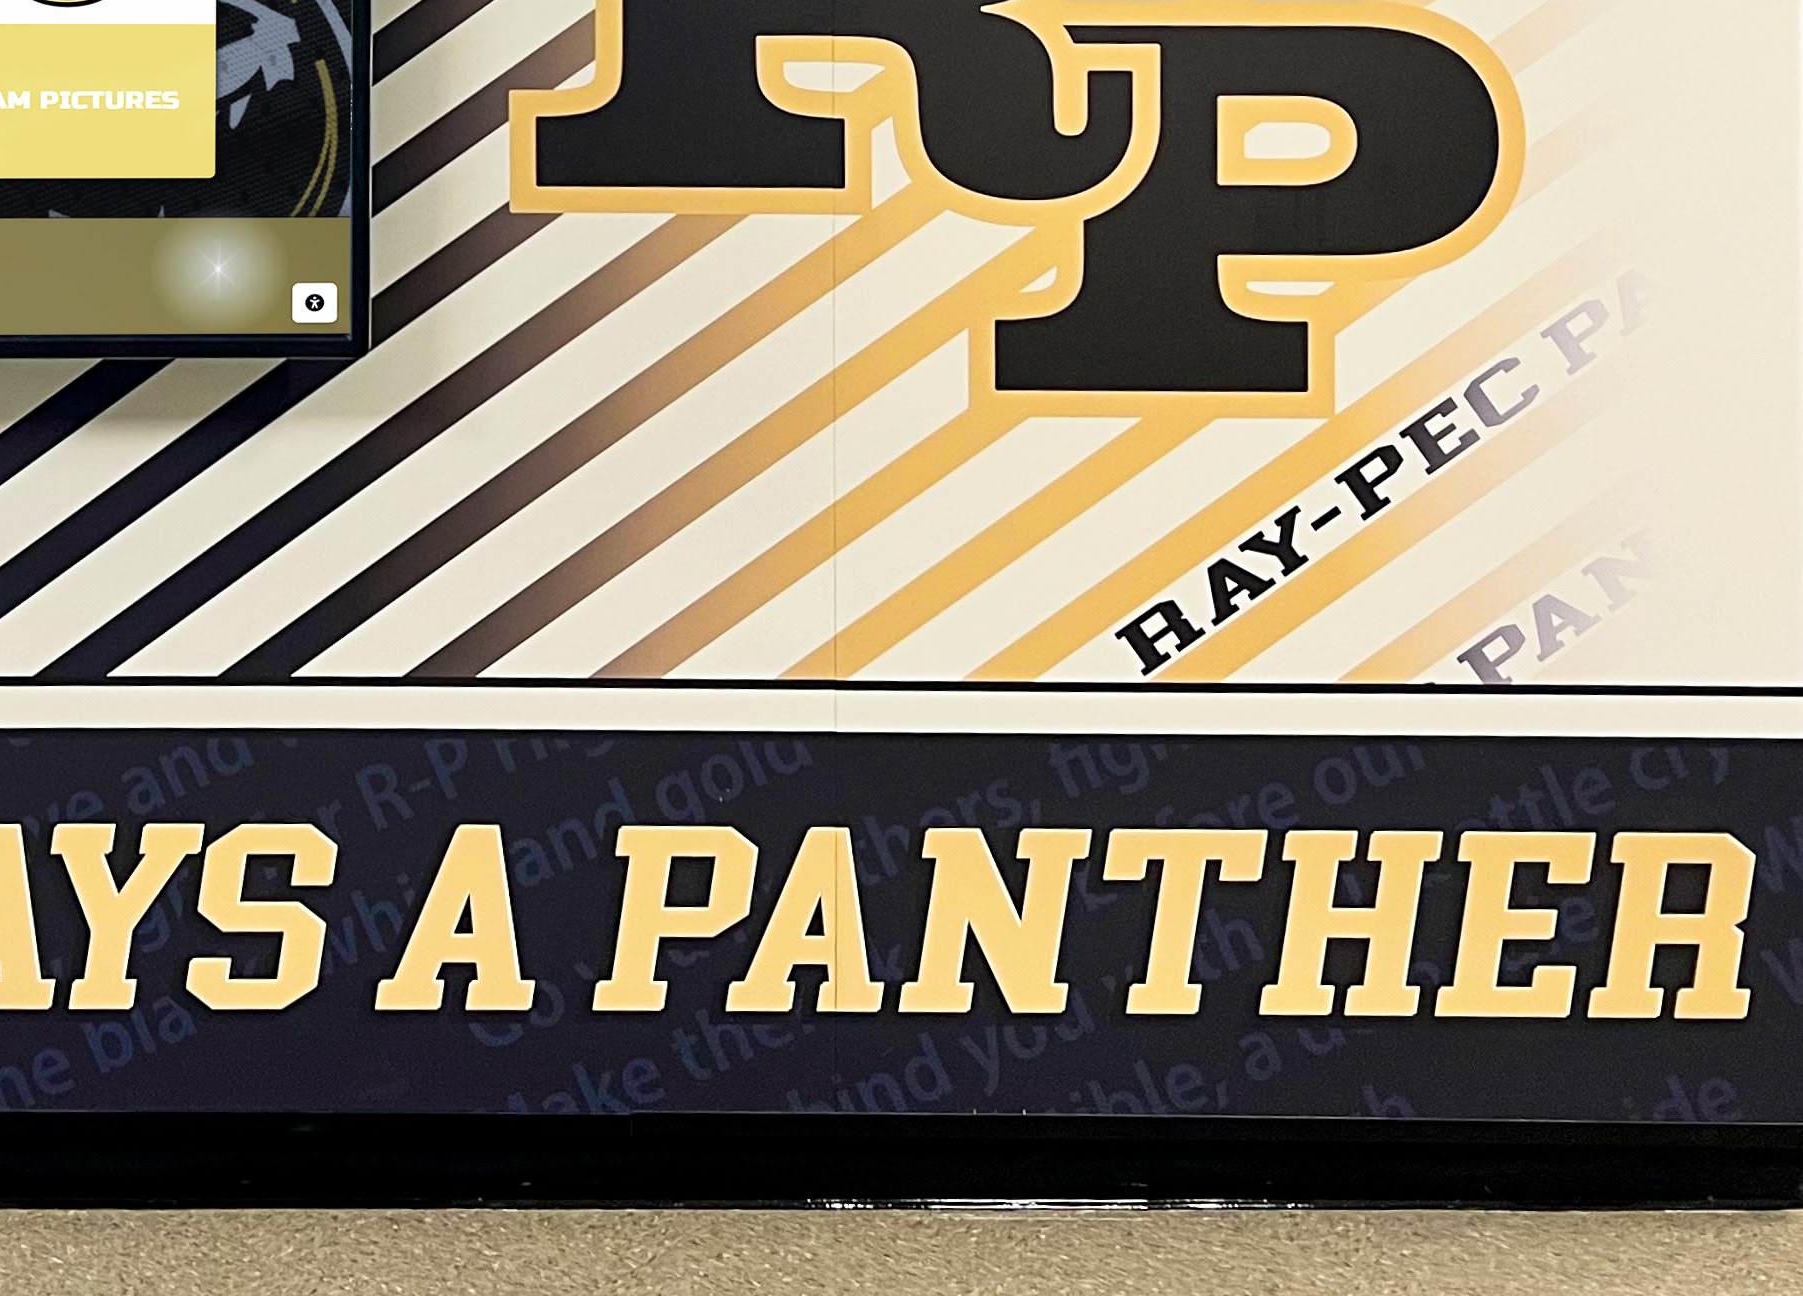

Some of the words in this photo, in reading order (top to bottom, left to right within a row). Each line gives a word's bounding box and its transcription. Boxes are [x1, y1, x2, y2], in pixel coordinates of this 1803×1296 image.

[40, 90, 181, 111] PICTURES
[1114, 357, 1540, 677] RAY-PEC
[375, 824, 533, 1011] A
[593, 825, 1755, 1020] PANTHER
